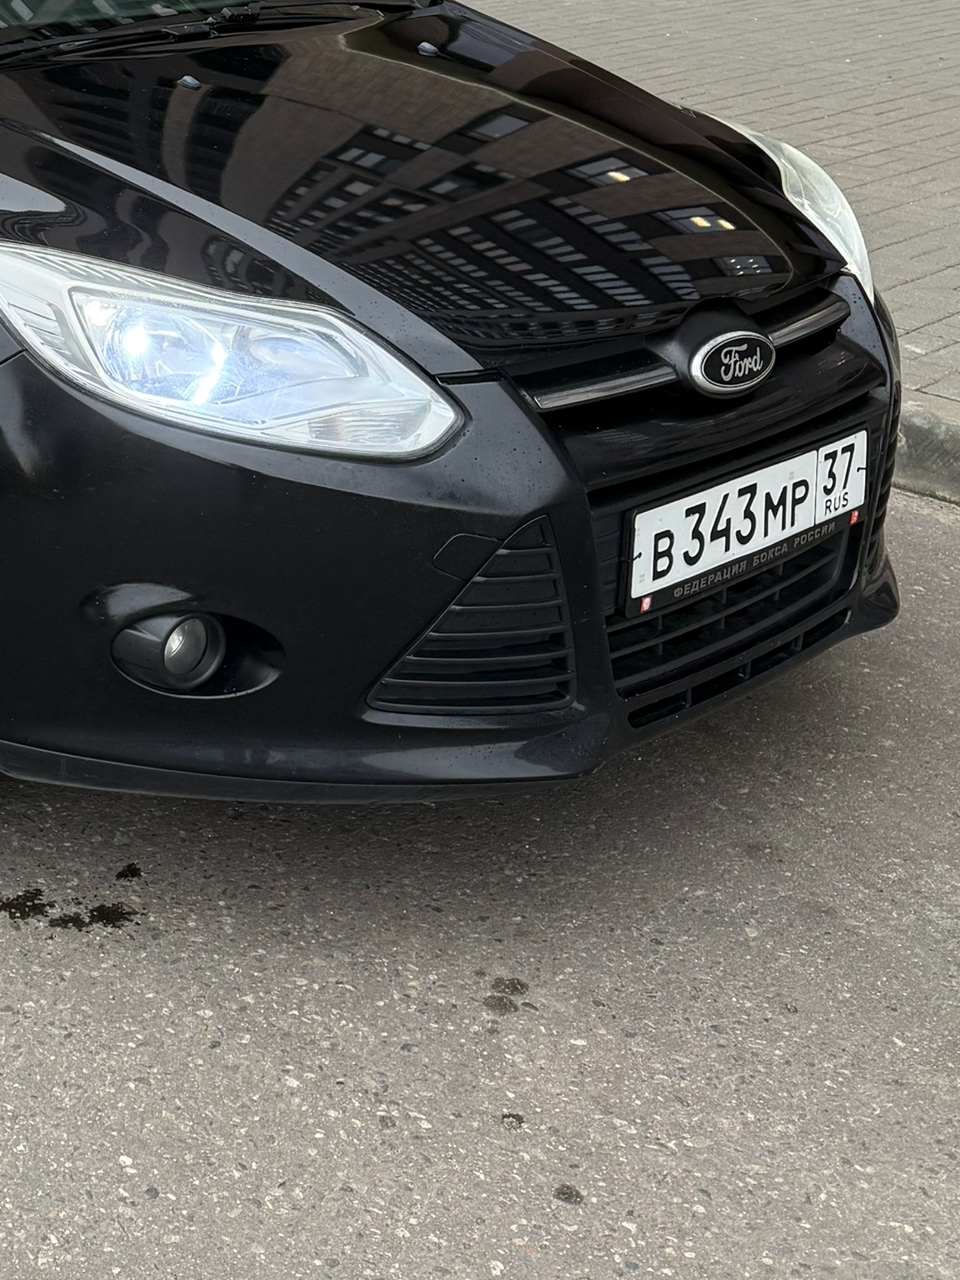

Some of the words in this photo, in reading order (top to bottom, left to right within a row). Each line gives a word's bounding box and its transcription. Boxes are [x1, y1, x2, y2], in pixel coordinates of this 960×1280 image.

[720, 343, 763, 382] Ford
[823, 442, 856, 496] 37
[824, 491, 849, 517] RUS
[673, 560, 747, 598] ФЕДЕРАЦИЯ
[752, 543, 789, 567] БОКСА
[793, 521, 836, 548] РОССИИ
